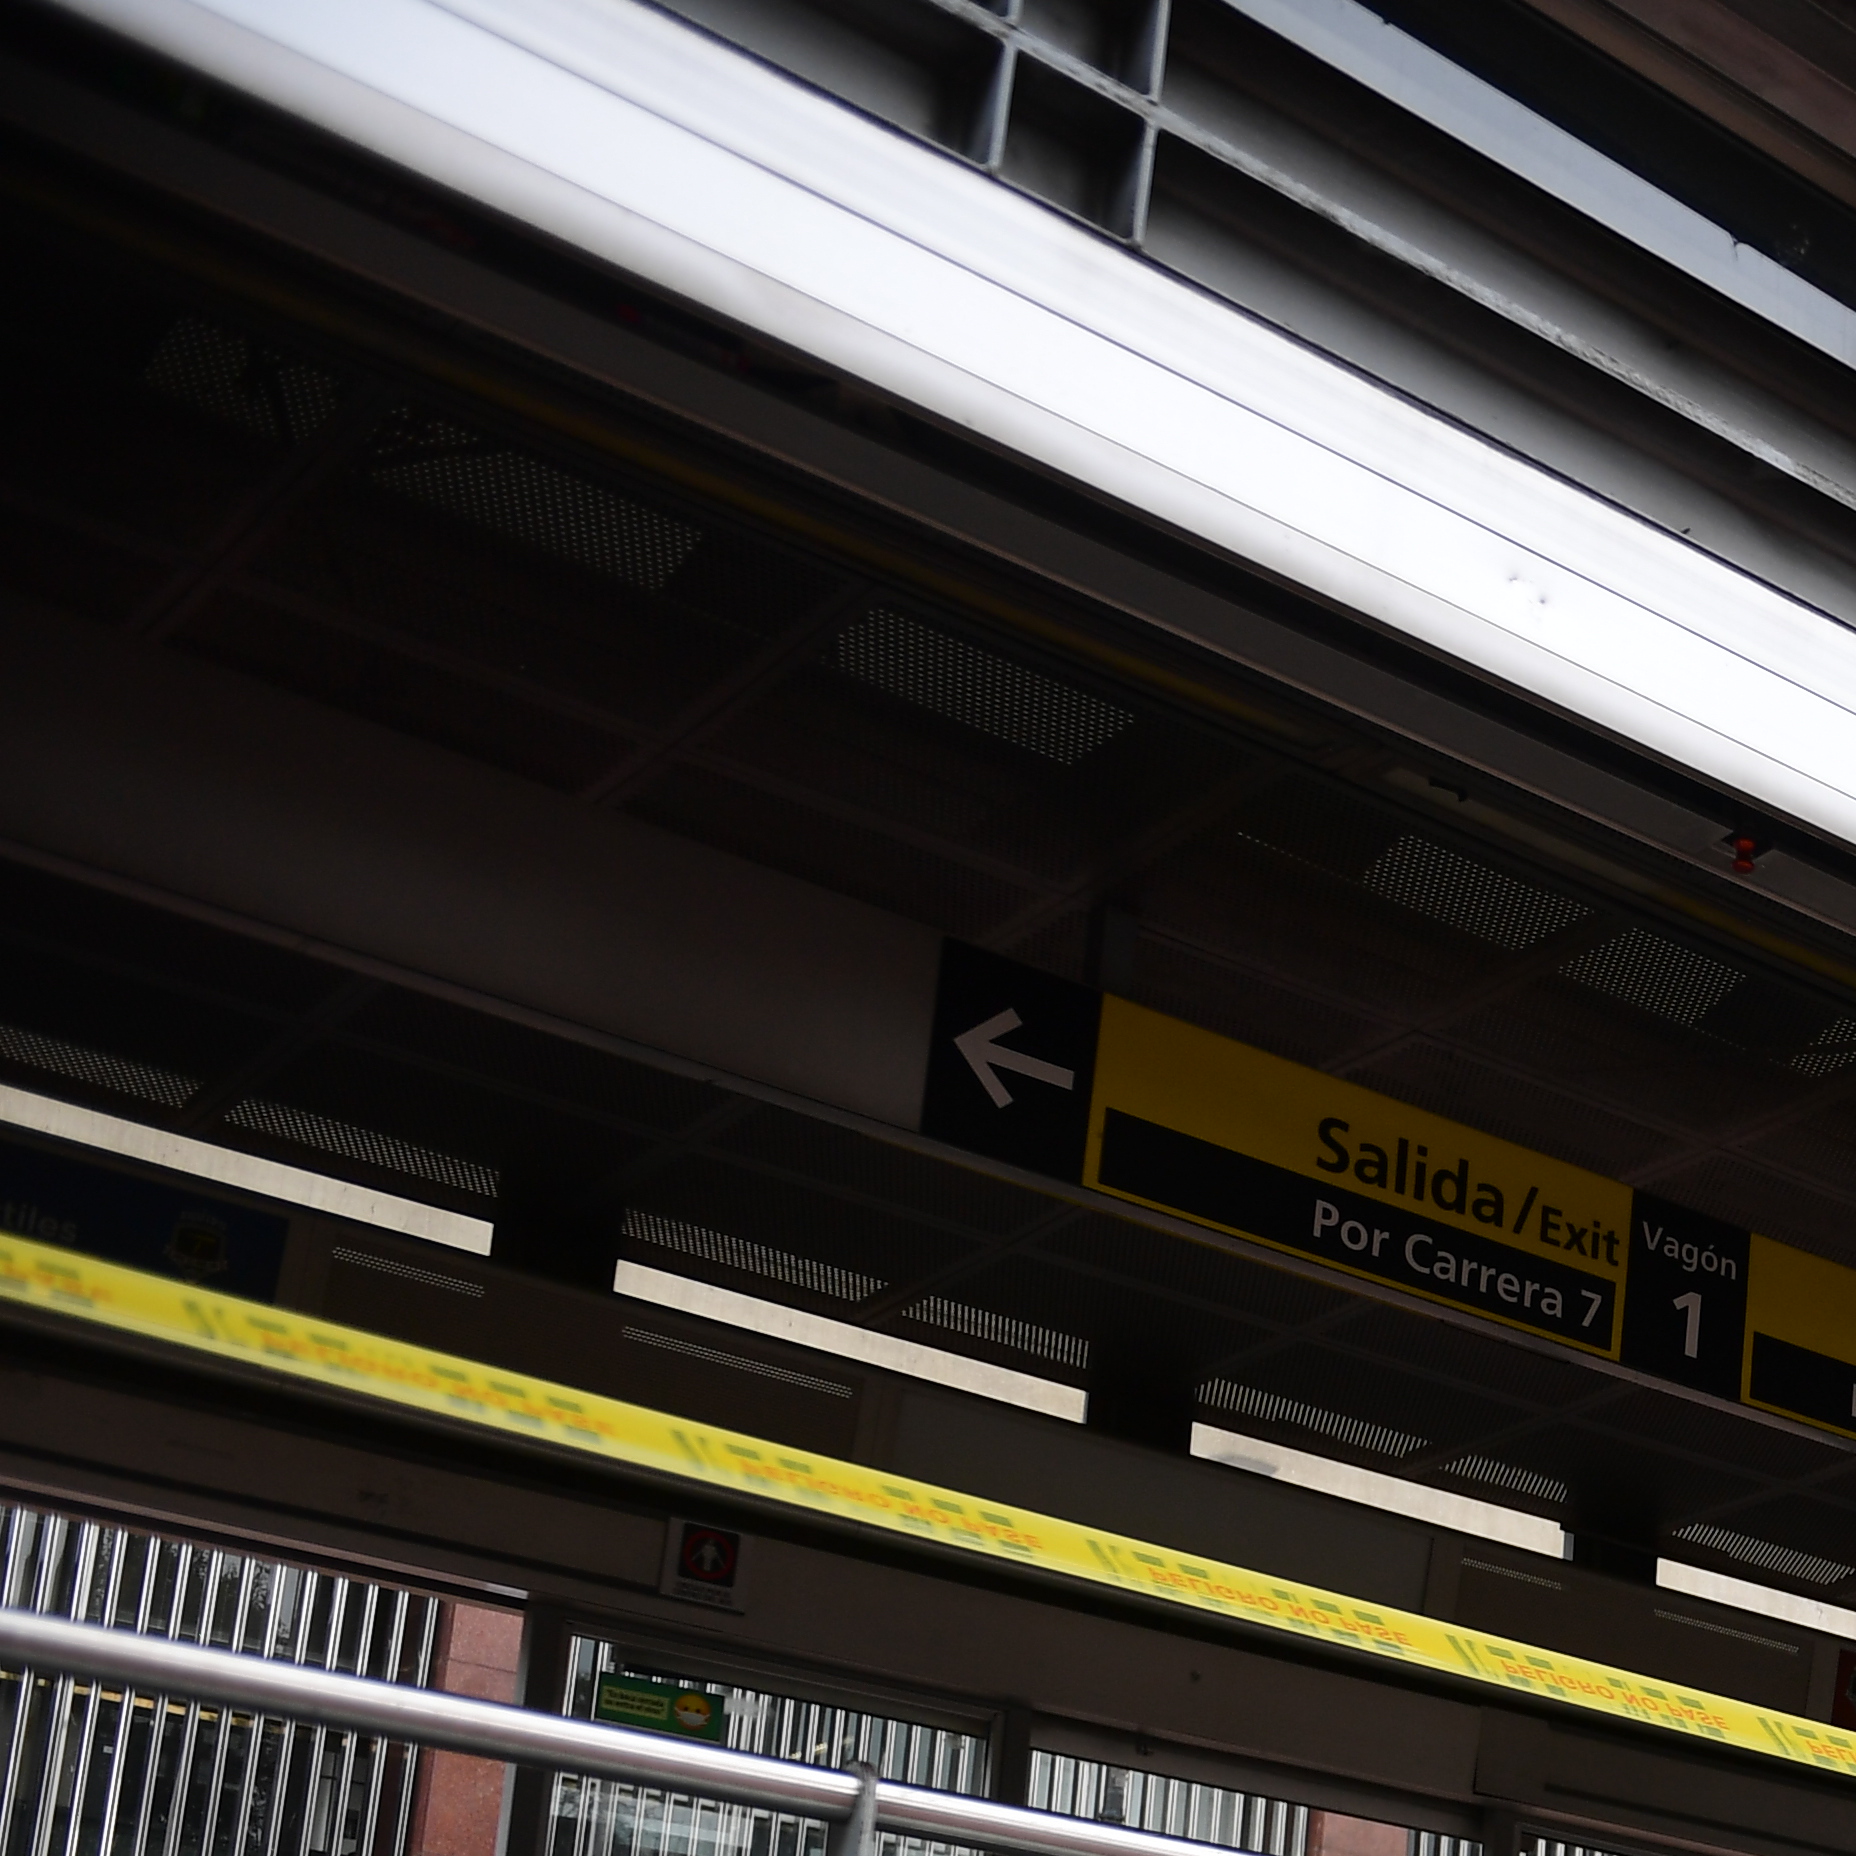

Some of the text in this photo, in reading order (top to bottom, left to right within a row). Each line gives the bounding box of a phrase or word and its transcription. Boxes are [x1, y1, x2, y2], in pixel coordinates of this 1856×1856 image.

[1317, 1117, 1620, 1267] Salida/Exit
[1312, 1200, 1603, 1327] Por Carrera 7
[1643, 1220, 1737, 1280] Vagón
[1672, 1292, 1702, 1359] 1
